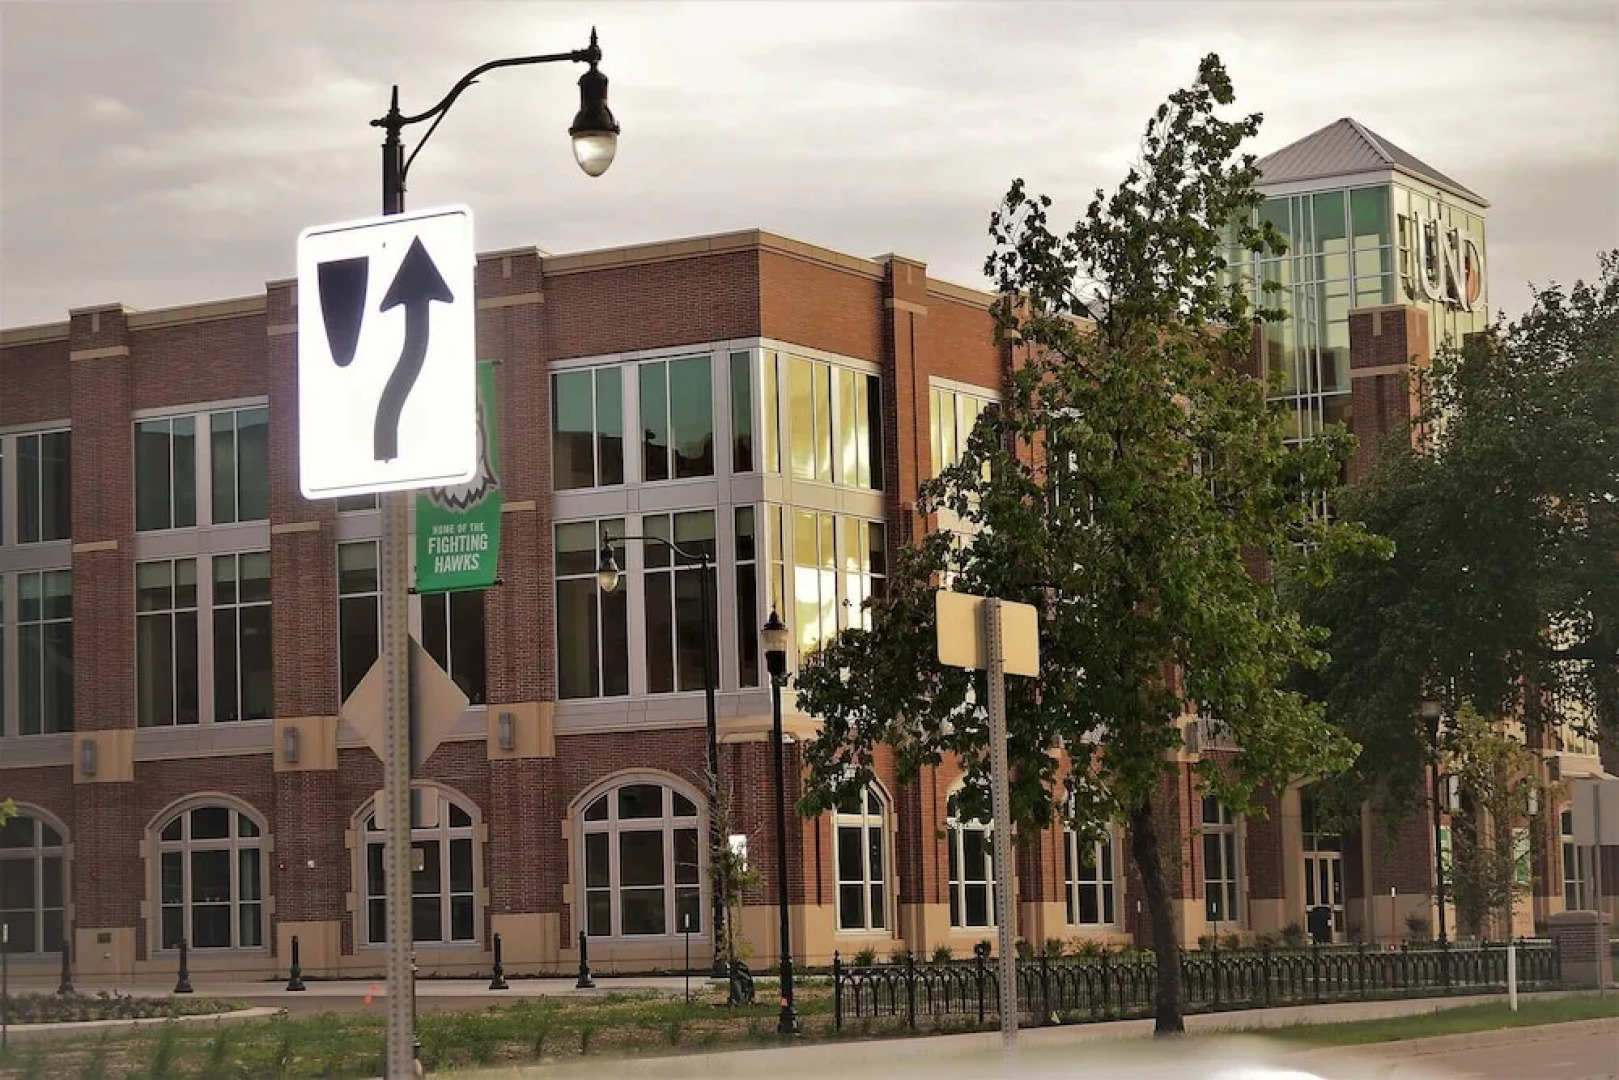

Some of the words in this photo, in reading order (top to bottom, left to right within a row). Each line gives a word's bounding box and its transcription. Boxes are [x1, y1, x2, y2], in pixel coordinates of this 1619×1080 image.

[1414, 210, 1487, 312] UND
[432, 524, 454, 535] HOME
[457, 523, 468, 533] OF
[470, 522, 485, 532] THE
[428, 533, 488, 555] FIGHTING
[434, 553, 480, 574] HAWKS
